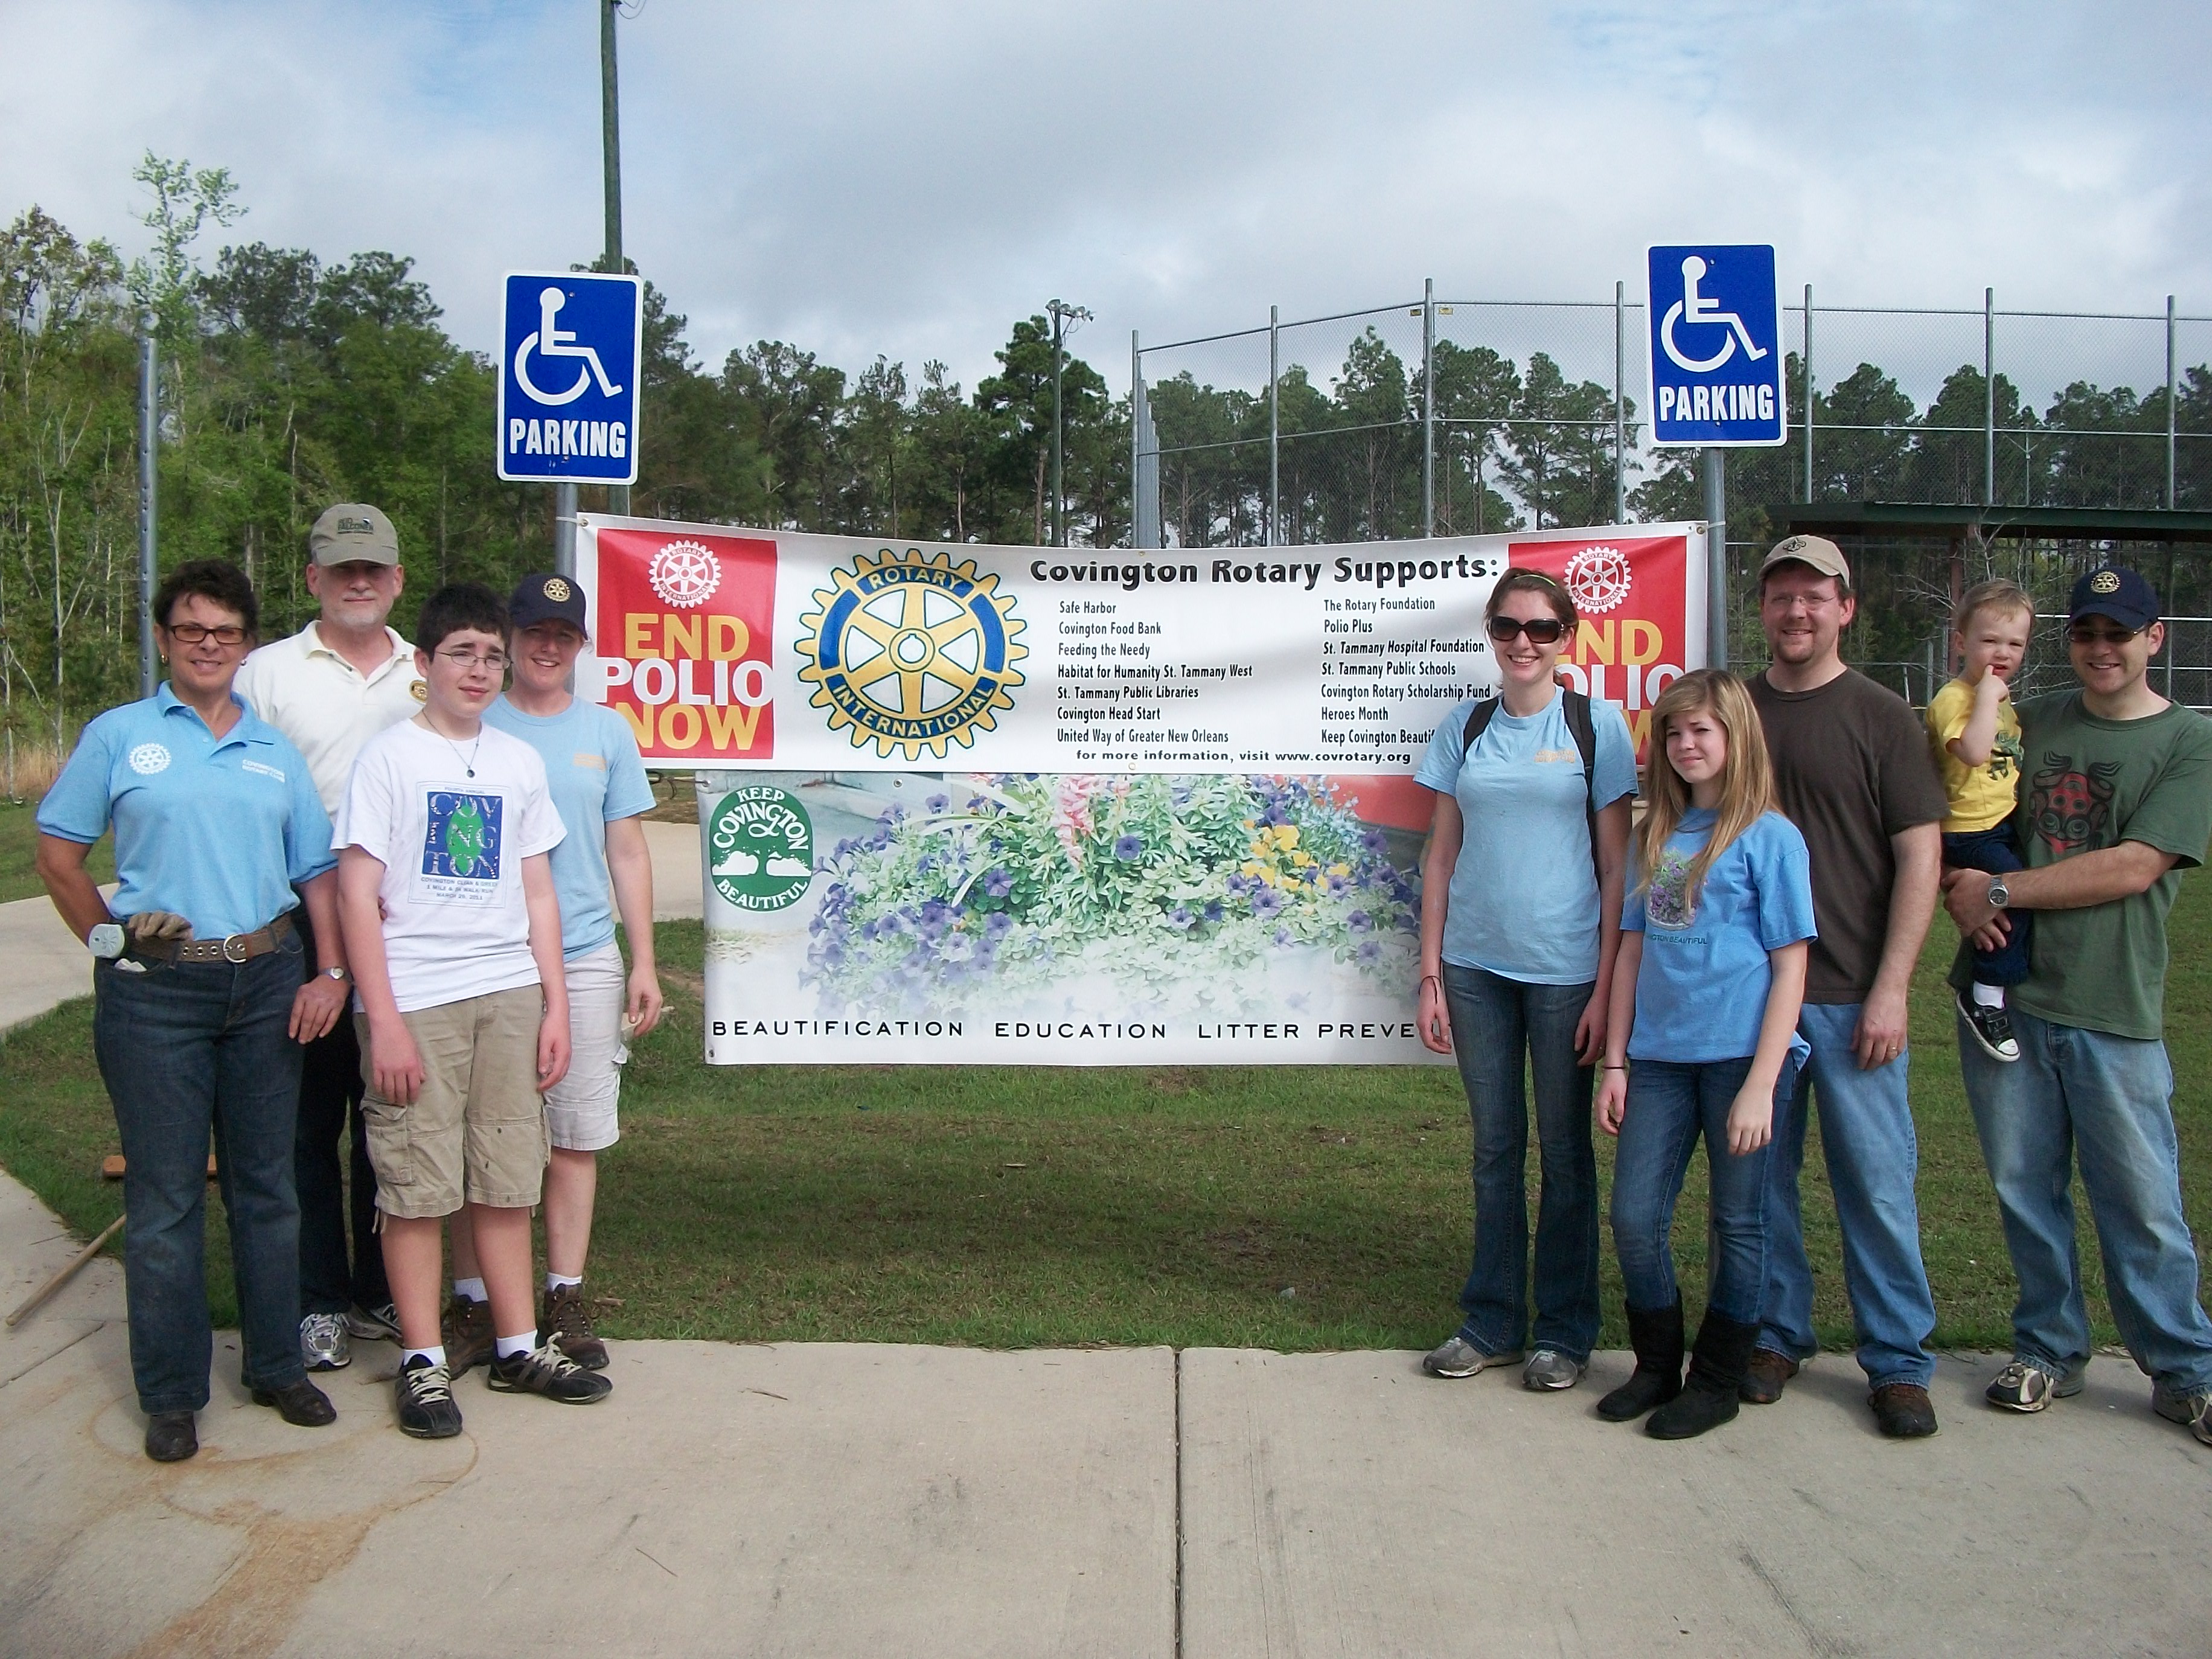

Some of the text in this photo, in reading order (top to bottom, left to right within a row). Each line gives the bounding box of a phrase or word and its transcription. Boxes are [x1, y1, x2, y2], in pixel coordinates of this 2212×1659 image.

[1659, 384, 1774, 421] PARKING
[510, 418, 627, 458] PARKING
[671, 548, 702, 557] ROTARY
[1584, 552, 1614, 561] ROTARY
[869, 567, 963, 590] ROTARY
[1030, 554, 1499, 591] Covington Rotary Supports:
[659, 583, 711, 601] INTERNATIONAL
[1573, 588, 1622, 606] INTERNATIONAL
[1060, 601, 1116, 613] Safe Harbor
[1325, 597, 1435, 613] The Rotary Foundation
[1060, 621, 1161, 638] Covington Food Bank
[1325, 619, 1372, 633] Polio Plus
[625, 613, 750, 662] END
[1555, 619, 1663, 665] ND
[1059, 643, 1150, 659] Feeding the Needy
[1323, 639, 1484, 656] St. Tammany Hospital Foundation
[1058, 664, 1252, 681] Habitat for Humanity St. Tammany West
[1322, 661, 1456, 679] St. Tammany Public Schools
[595, 656, 775, 708] POLIO
[1058, 686, 1198, 702] St. Tammany Public Libraries
[1322, 684, 1491, 702] Covington Rotary Scholarship Fund
[833, 685, 994, 737] INTERNATIONAL
[1058, 706, 1160, 723] Covington Head Start
[1322, 706, 1389, 720] Heroes Month
[615, 702, 762, 750] NOW
[1058, 729, 1229, 746] United Way of Greater New Orleans
[1322, 729, 1435, 747] Keep Covington Beauti
[1076, 750, 1096, 759] for
[1145, 750, 1233, 762] information,
[1239, 750, 1269, 761] visit
[1275, 753, 1410, 764] www.covrotary.org
[736, 787, 785, 802] KEEP
[713, 801, 809, 850] COVINGTON
[717, 878, 808, 909] BEAUTIFUL
[1669, 935, 1708, 945] BEAUTIFUL
[713, 1020, 1415, 1038] BEAUTIFICATION EDUCATION LITTER PREVE
